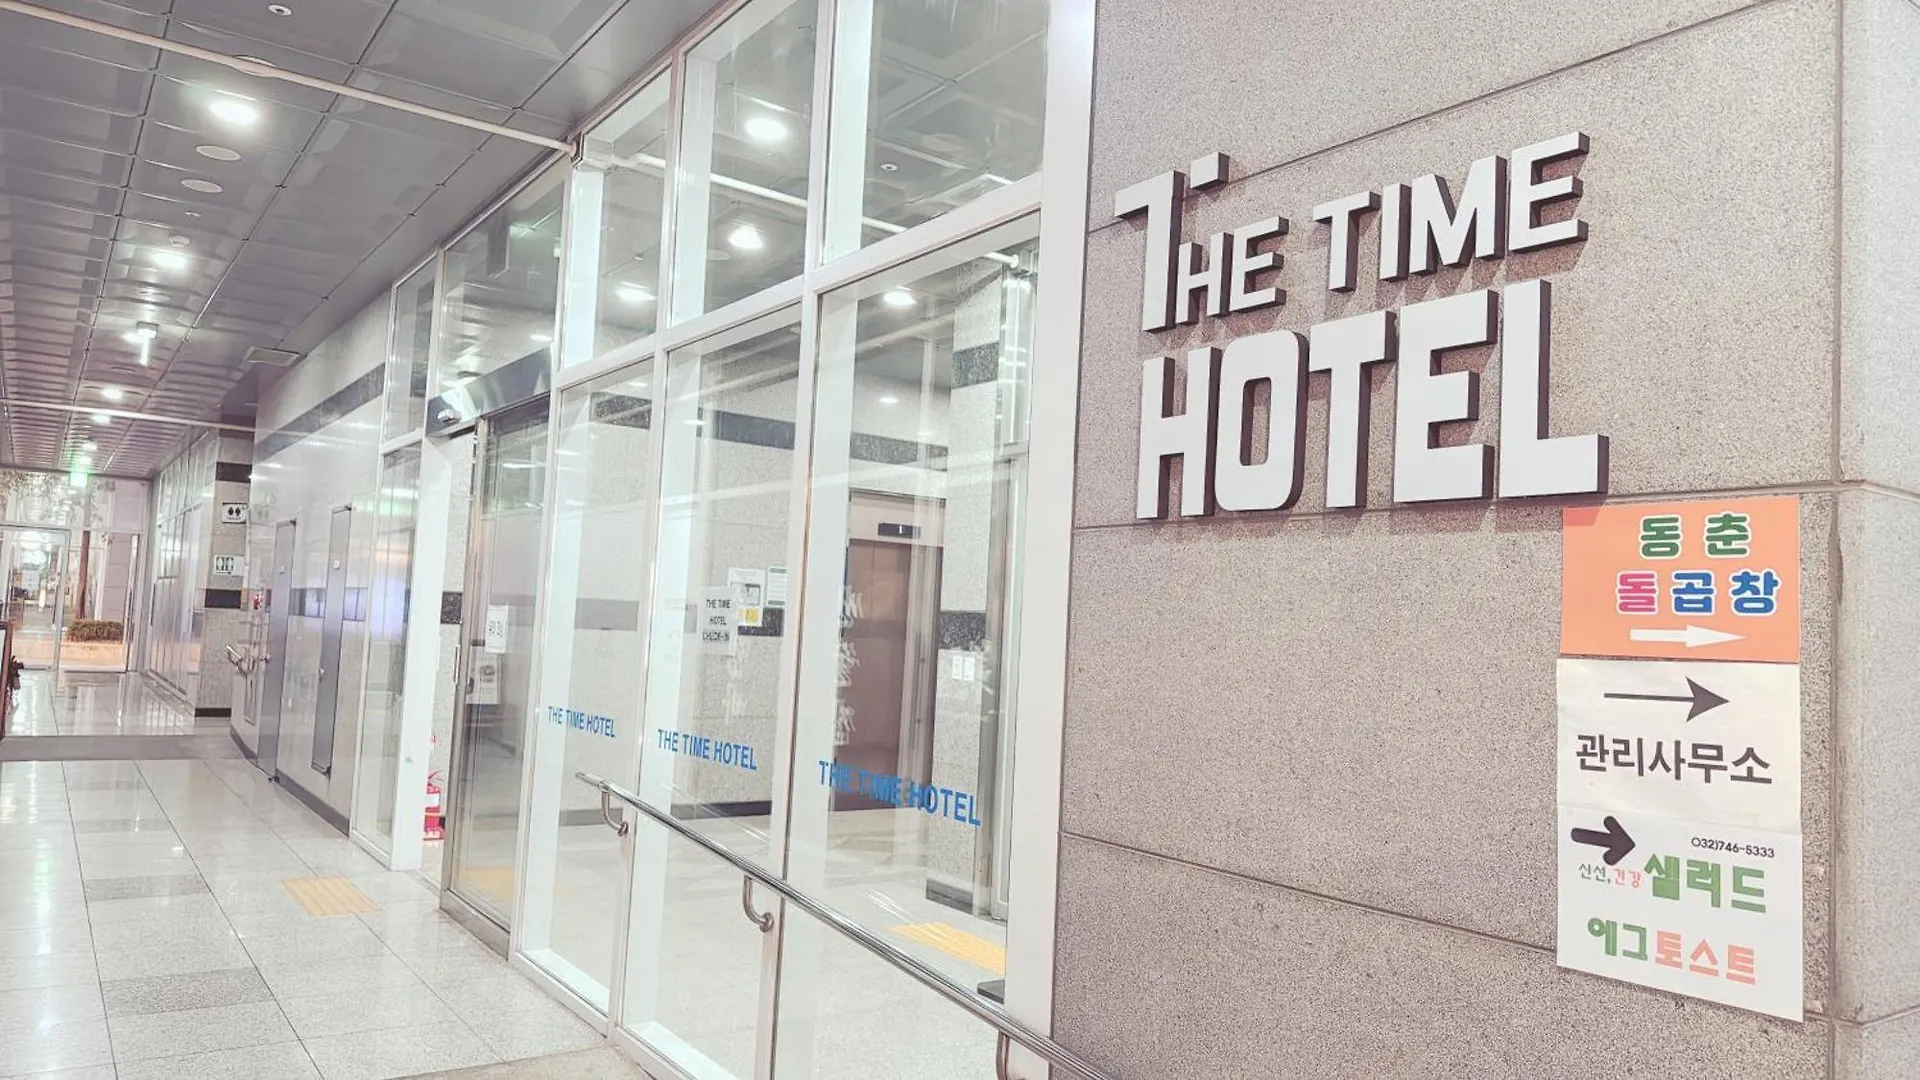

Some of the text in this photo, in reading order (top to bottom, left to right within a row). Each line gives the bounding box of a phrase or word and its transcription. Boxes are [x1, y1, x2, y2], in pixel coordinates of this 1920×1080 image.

[1115, 131, 1590, 332] THE TIME
[1137, 279, 1609, 519] HOTEL
[548, 706, 616, 738] THE TIME HOTEL
[657, 728, 758, 771] THE TIME HOTEL
[1576, 734, 1773, 784] 관리사무소
[818, 760, 981, 827] THE TIME HOTEL
[1691, 836, 1776, 859] 032)746-5333
